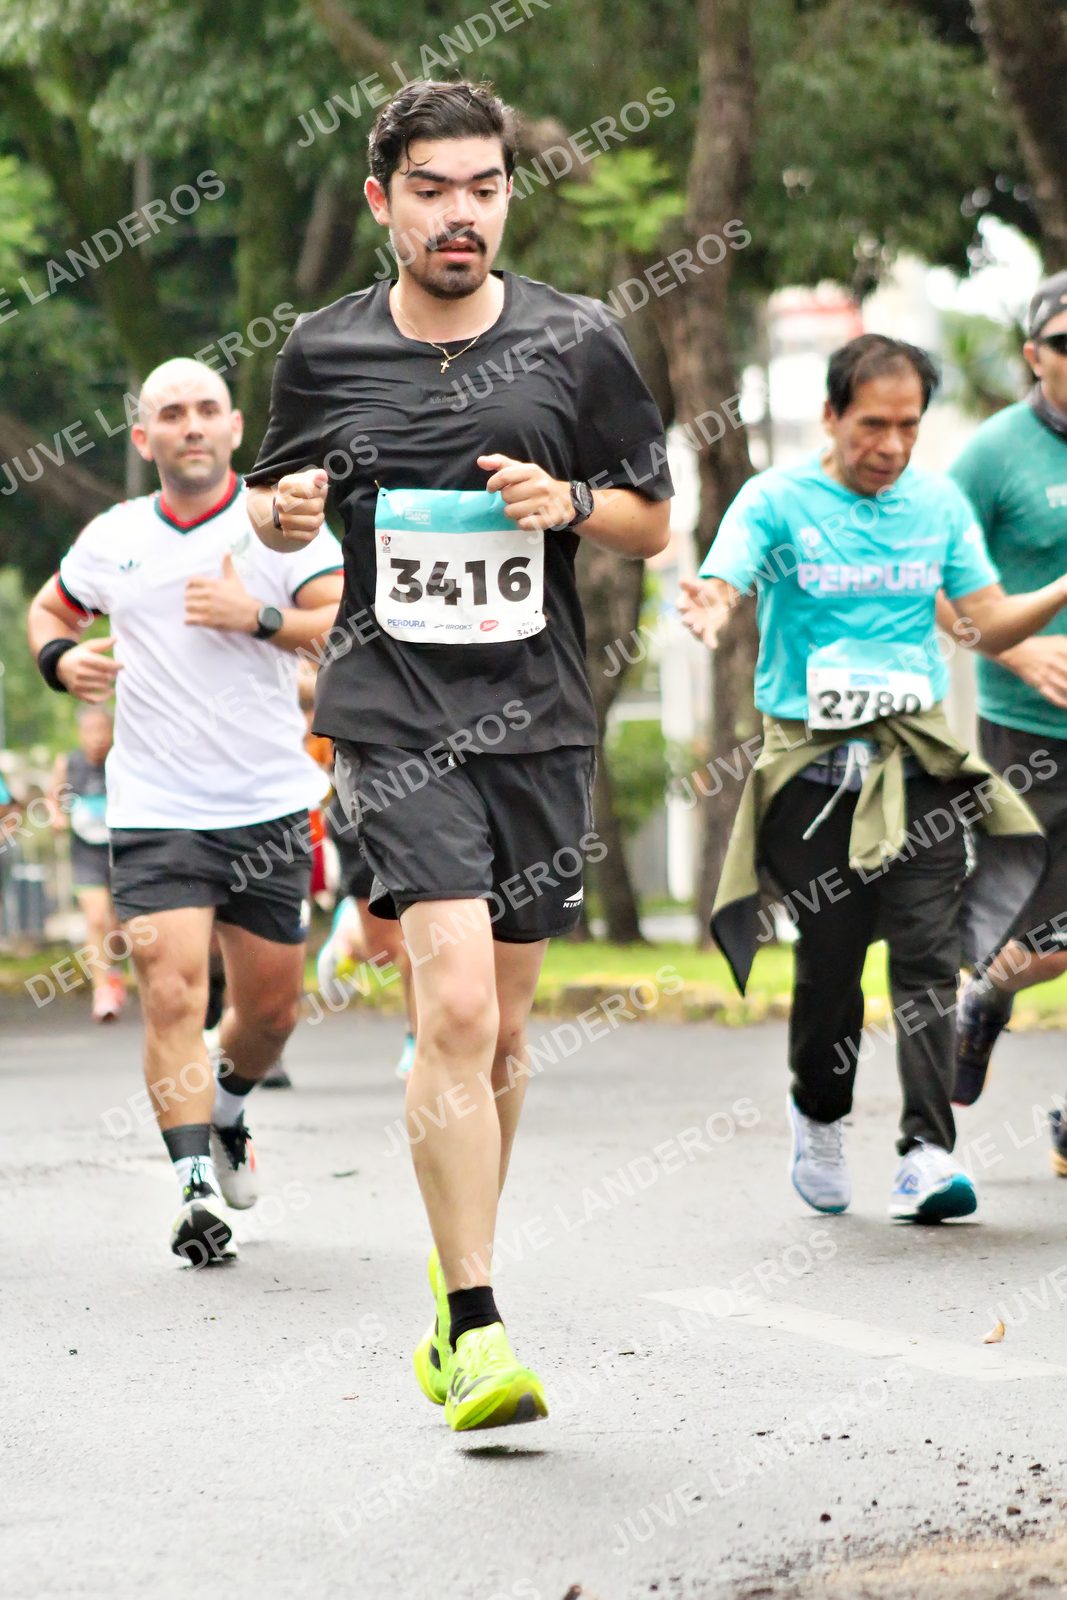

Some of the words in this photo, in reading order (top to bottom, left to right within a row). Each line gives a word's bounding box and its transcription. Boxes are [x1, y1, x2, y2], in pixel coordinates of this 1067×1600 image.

[388, 556, 532, 606] 3416
[797, 560, 943, 593] PERDURA
[387, 618, 426, 628] PERDURA
[445, 623, 473, 631] BROOKS
[516, 625, 541, 637] 3416
[818, 690, 922, 720] 2780
